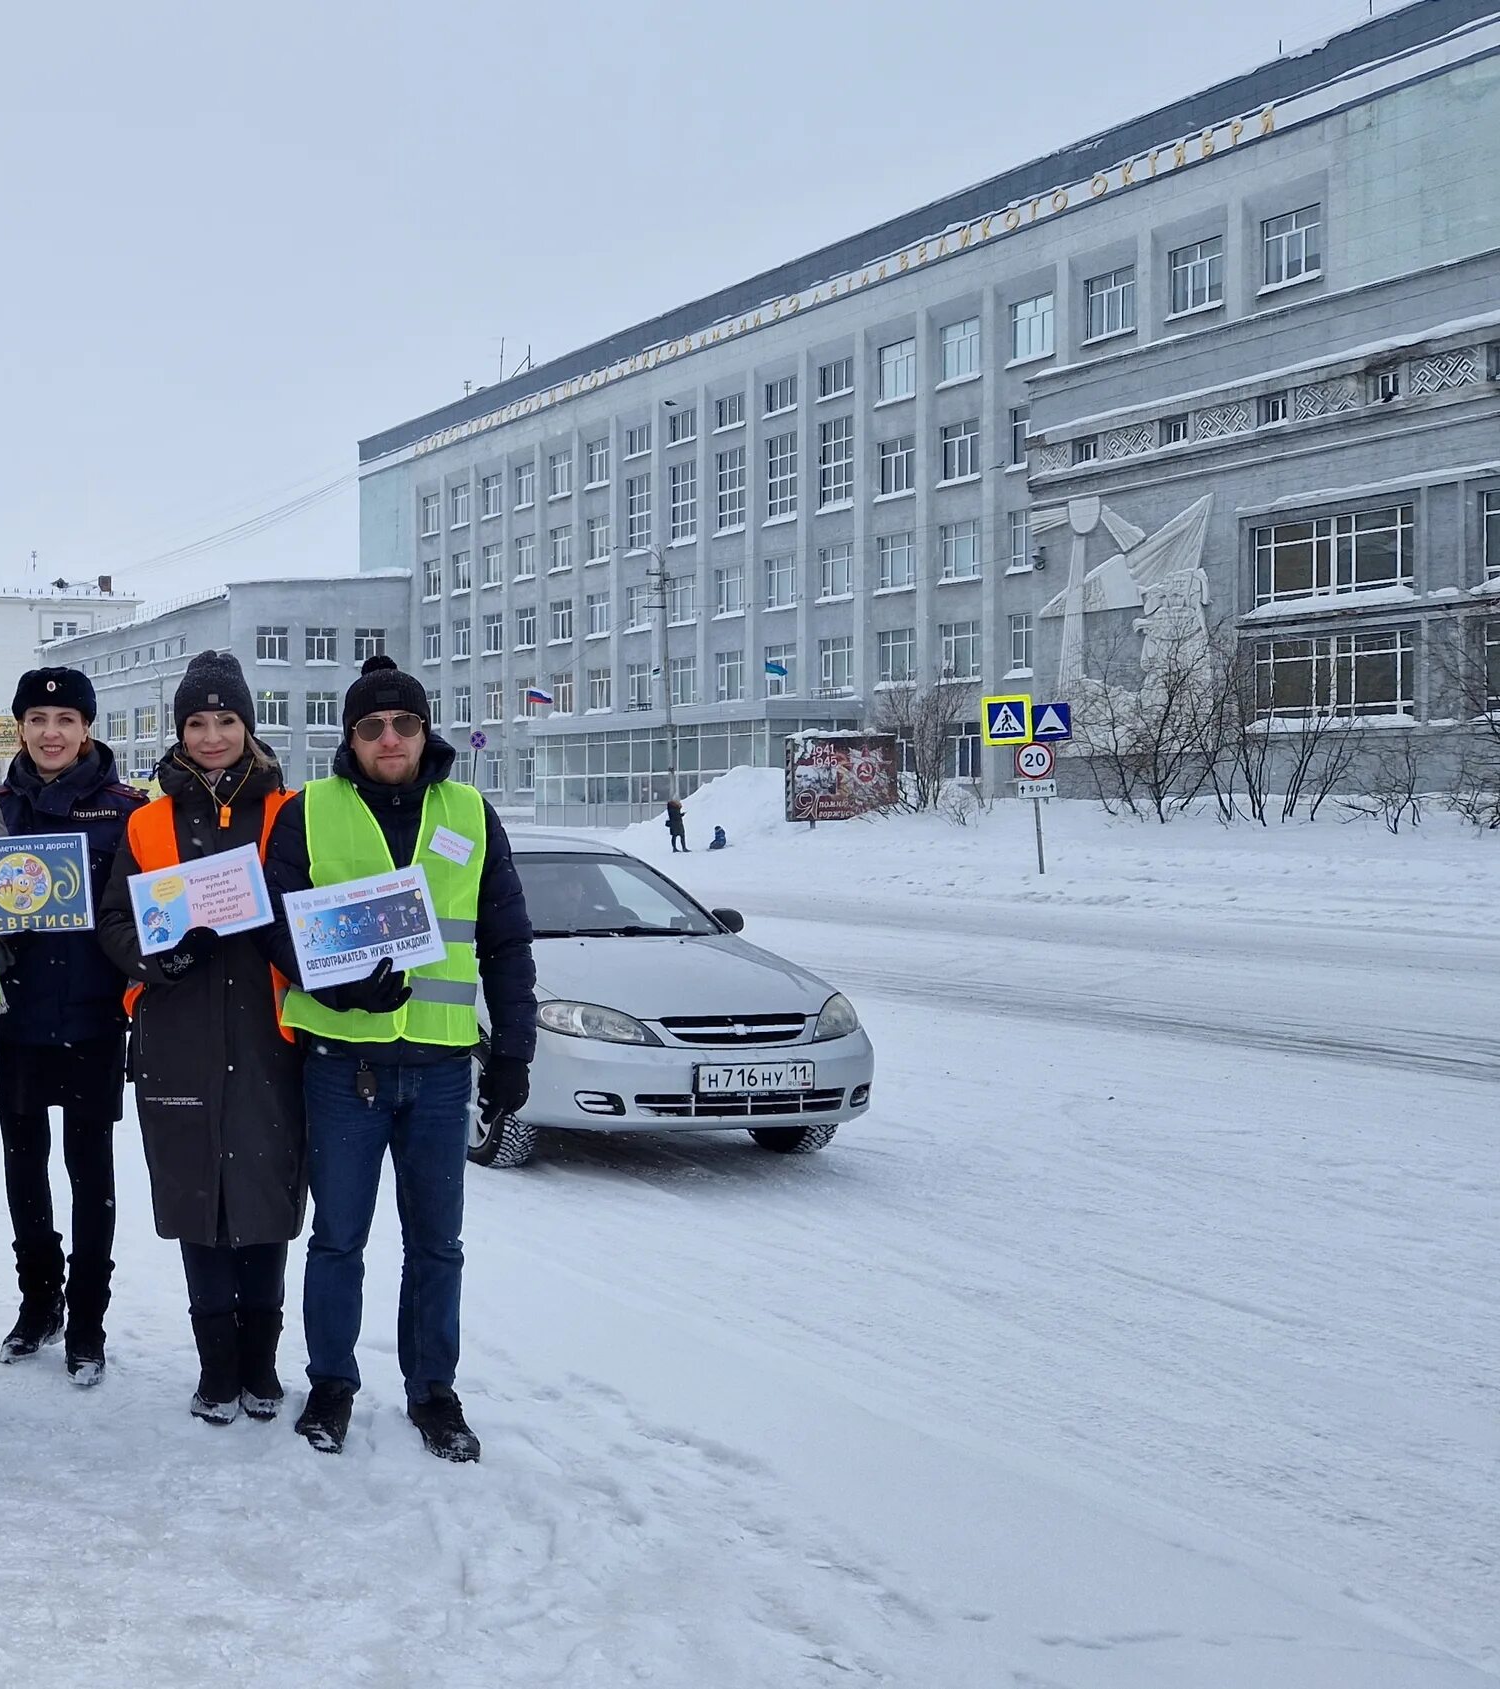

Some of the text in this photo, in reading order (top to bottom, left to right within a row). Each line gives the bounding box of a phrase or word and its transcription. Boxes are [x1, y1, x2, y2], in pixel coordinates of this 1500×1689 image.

[700, 312, 762, 347] ИМЕНИ
[812, 263, 887, 305] ЛЕТИЯ
[899, 188, 1068, 272] ВЕЛИКОГО
[1090, 107, 1274, 197] ОКТЯБРЯ
[813, 744, 835, 757] 1941
[812, 755, 838, 768] 1945
[1025, 753, 1045, 767] 20
[73, 809, 117, 818] ПОЛИЦИЯ
[46, 840, 77, 851] дороге!
[205, 879, 230, 890] купите
[201, 885, 238, 901] родители!
[192, 901, 214, 912] Пусть
[227, 891, 251, 903] дороге
[306, 950, 368, 971] СВЕТООТРАЖАТЕЛЬ
[370, 945, 394, 958] НУЖЕН
[396, 933, 432, 951] КАЖДОМУ!
[790, 1066, 807, 1080] 11
